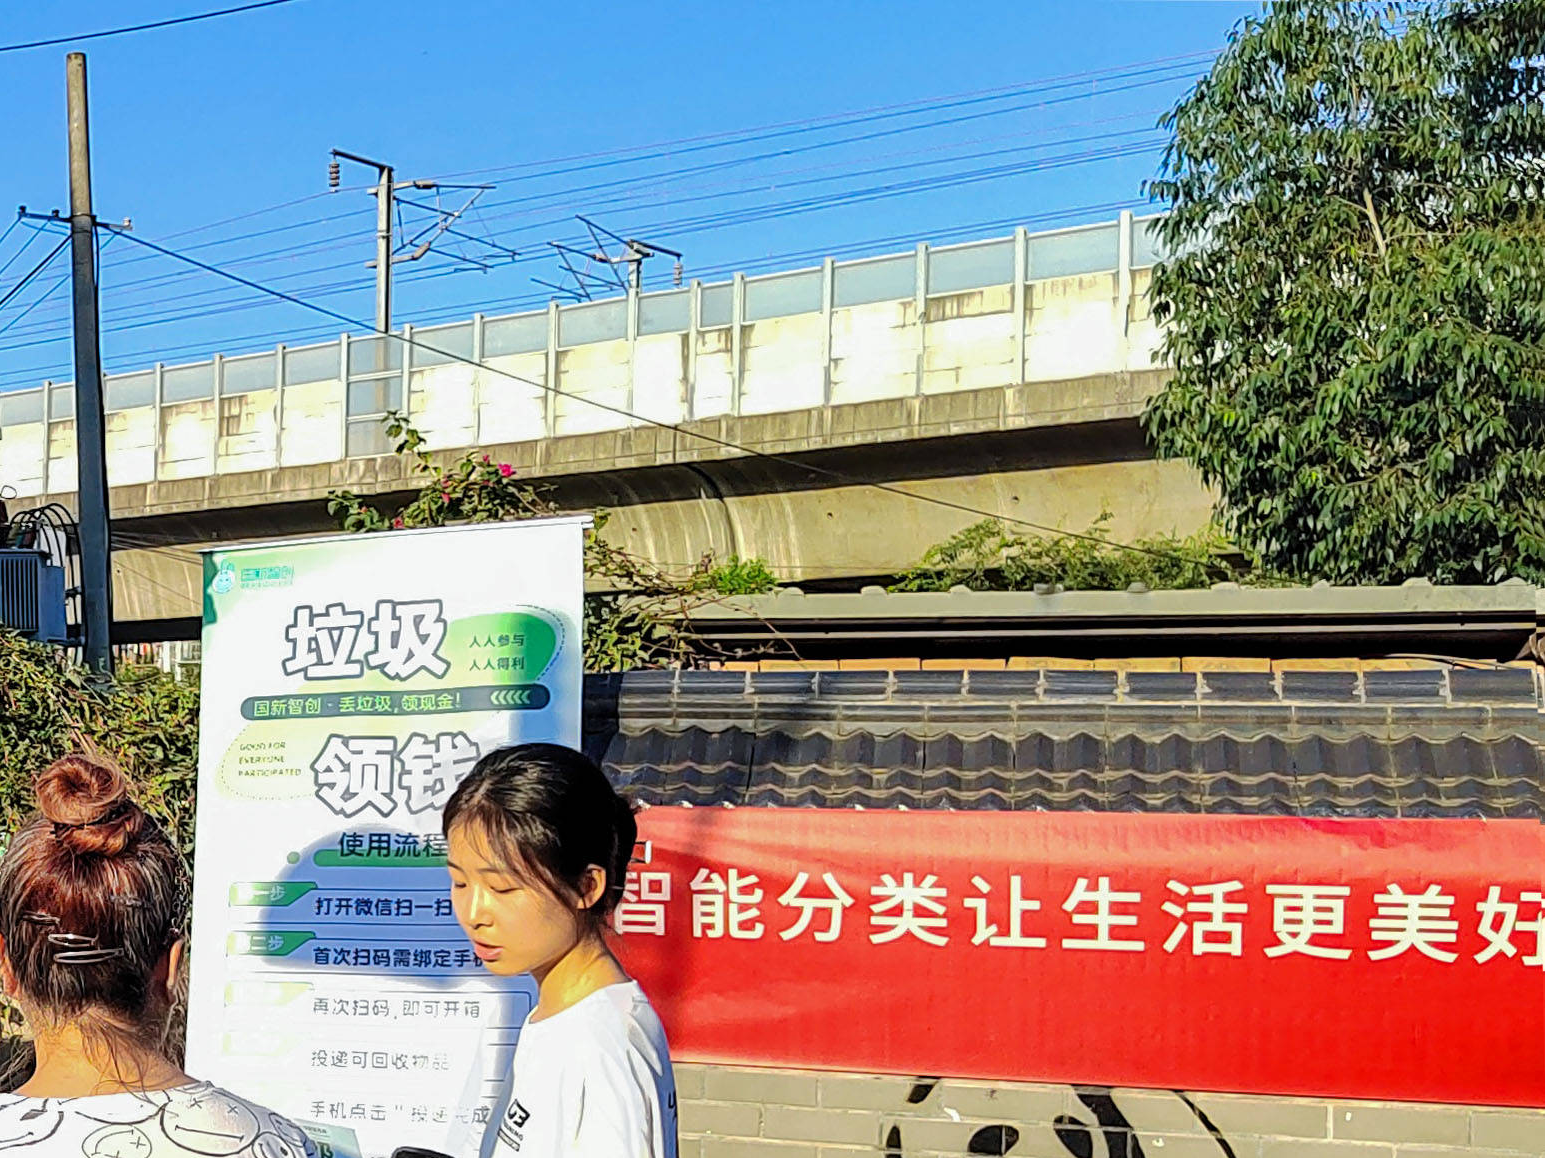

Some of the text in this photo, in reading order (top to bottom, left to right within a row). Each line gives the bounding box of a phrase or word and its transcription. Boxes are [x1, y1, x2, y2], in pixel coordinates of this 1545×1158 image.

[282, 599, 451, 681] 垃圾
[469, 633, 525, 650] 人人参与
[469, 656, 525, 672] 人人得利
[311, 732, 480, 818] 领钱
[339, 832, 448, 858] 使用流程
[315, 896, 453, 917] 打开微信扫一扫
[613, 866, 1545, 972] 智能分类让生活更美好
